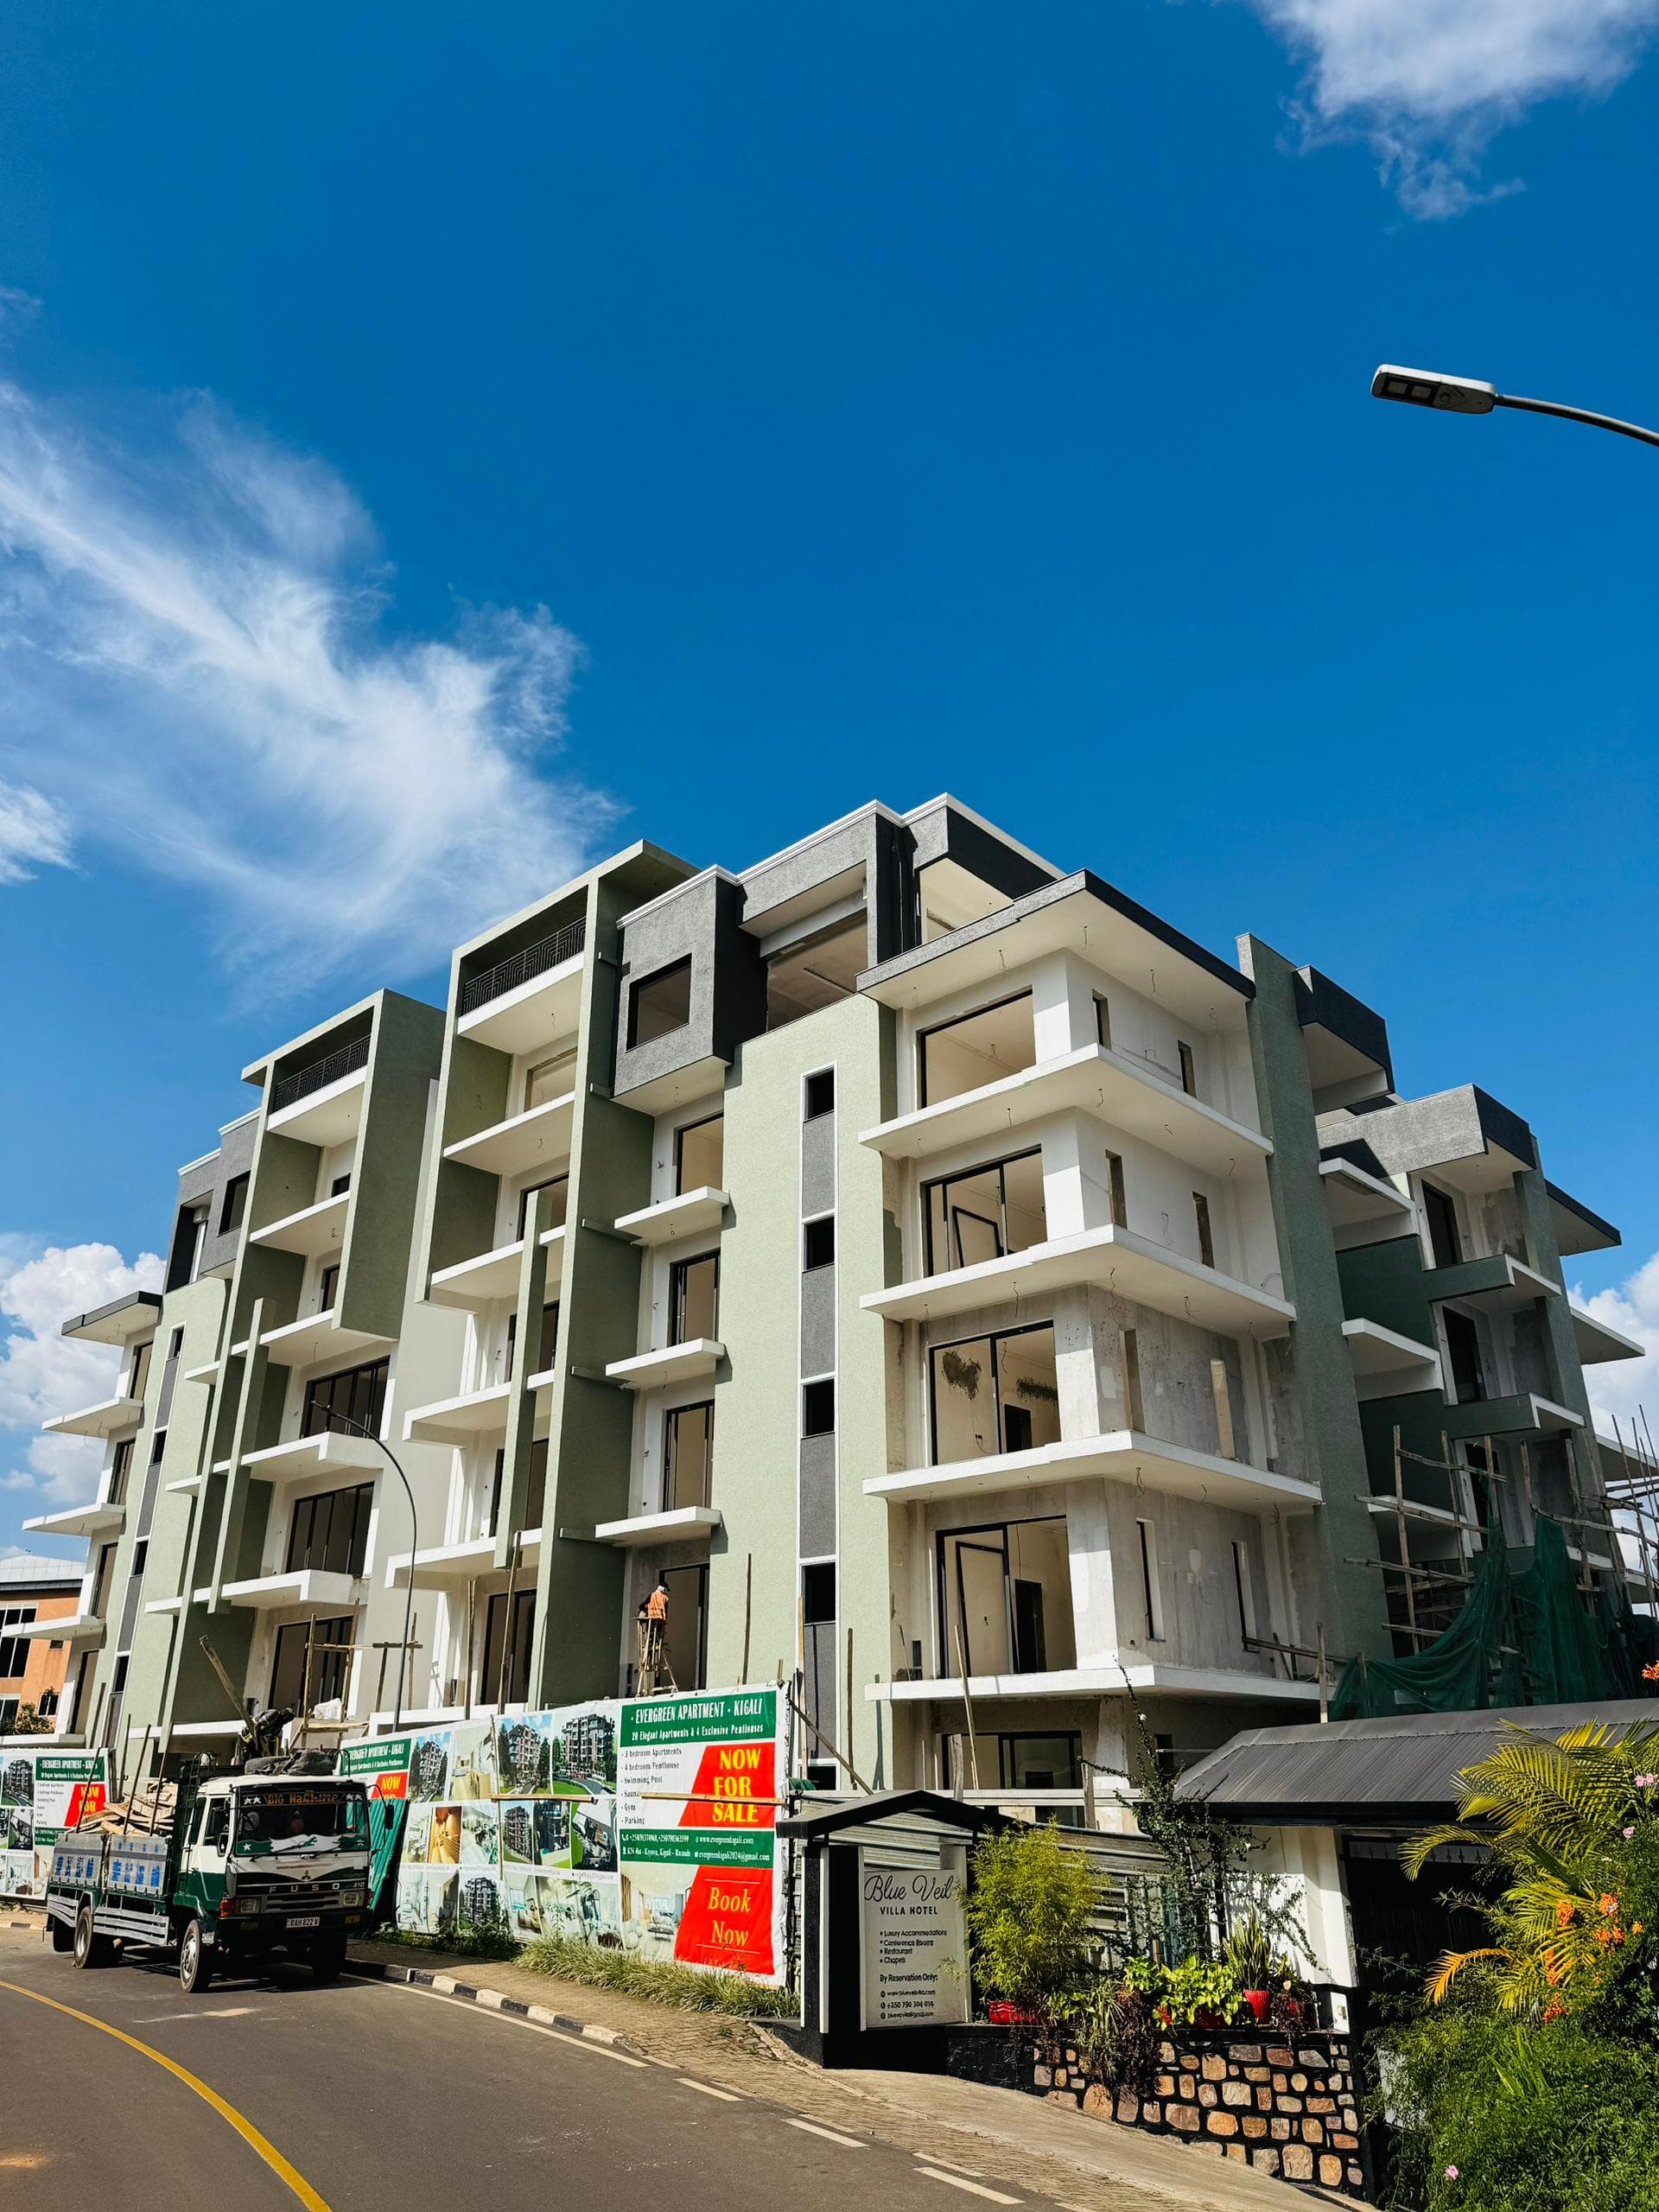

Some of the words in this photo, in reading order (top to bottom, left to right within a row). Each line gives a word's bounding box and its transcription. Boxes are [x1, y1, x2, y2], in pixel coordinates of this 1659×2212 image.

[636, 1706, 676, 1724] EVERGREEN
[677, 1701, 725, 1719] APARTMENT
[734, 1698, 763, 1716] KIGALI
[639, 1730, 658, 1742] Elegant
[659, 1728, 690, 1740] Apartments
[702, 1726, 728, 1737] Exclusive
[731, 1724, 764, 1734] Penthouses
[629, 1749, 652, 1758] bedroom
[652, 1747, 683, 1758] Apartments
[720, 1748, 761, 1770] NOW
[652, 1761, 680, 1770] Penthouse
[382, 1776, 402, 1790] NOW
[624, 1776, 650, 1785] Swimming
[651, 1775, 664, 1783] Pool
[714, 1776, 753, 1797] FOR
[624, 1803, 636, 1812] Gym
[712, 1802, 760, 1823] SALE
[624, 1816, 645, 1825] Parking
[269, 1883, 340, 1894] FUSO
[864, 1874, 907, 1903] Blue
[912, 1874, 955, 1902] Veil
[708, 1886, 753, 1913] Book
[880, 1906, 906, 1916] VILLA
[909, 1906, 938, 1916] HOTEL
[711, 1920, 749, 1947] Now
[916, 1938, 934, 1947] Rooms
[883, 1956, 906, 1966] Chapels
[880, 1974, 888, 1984] By
[888, 1973, 923, 1982] Reservation
